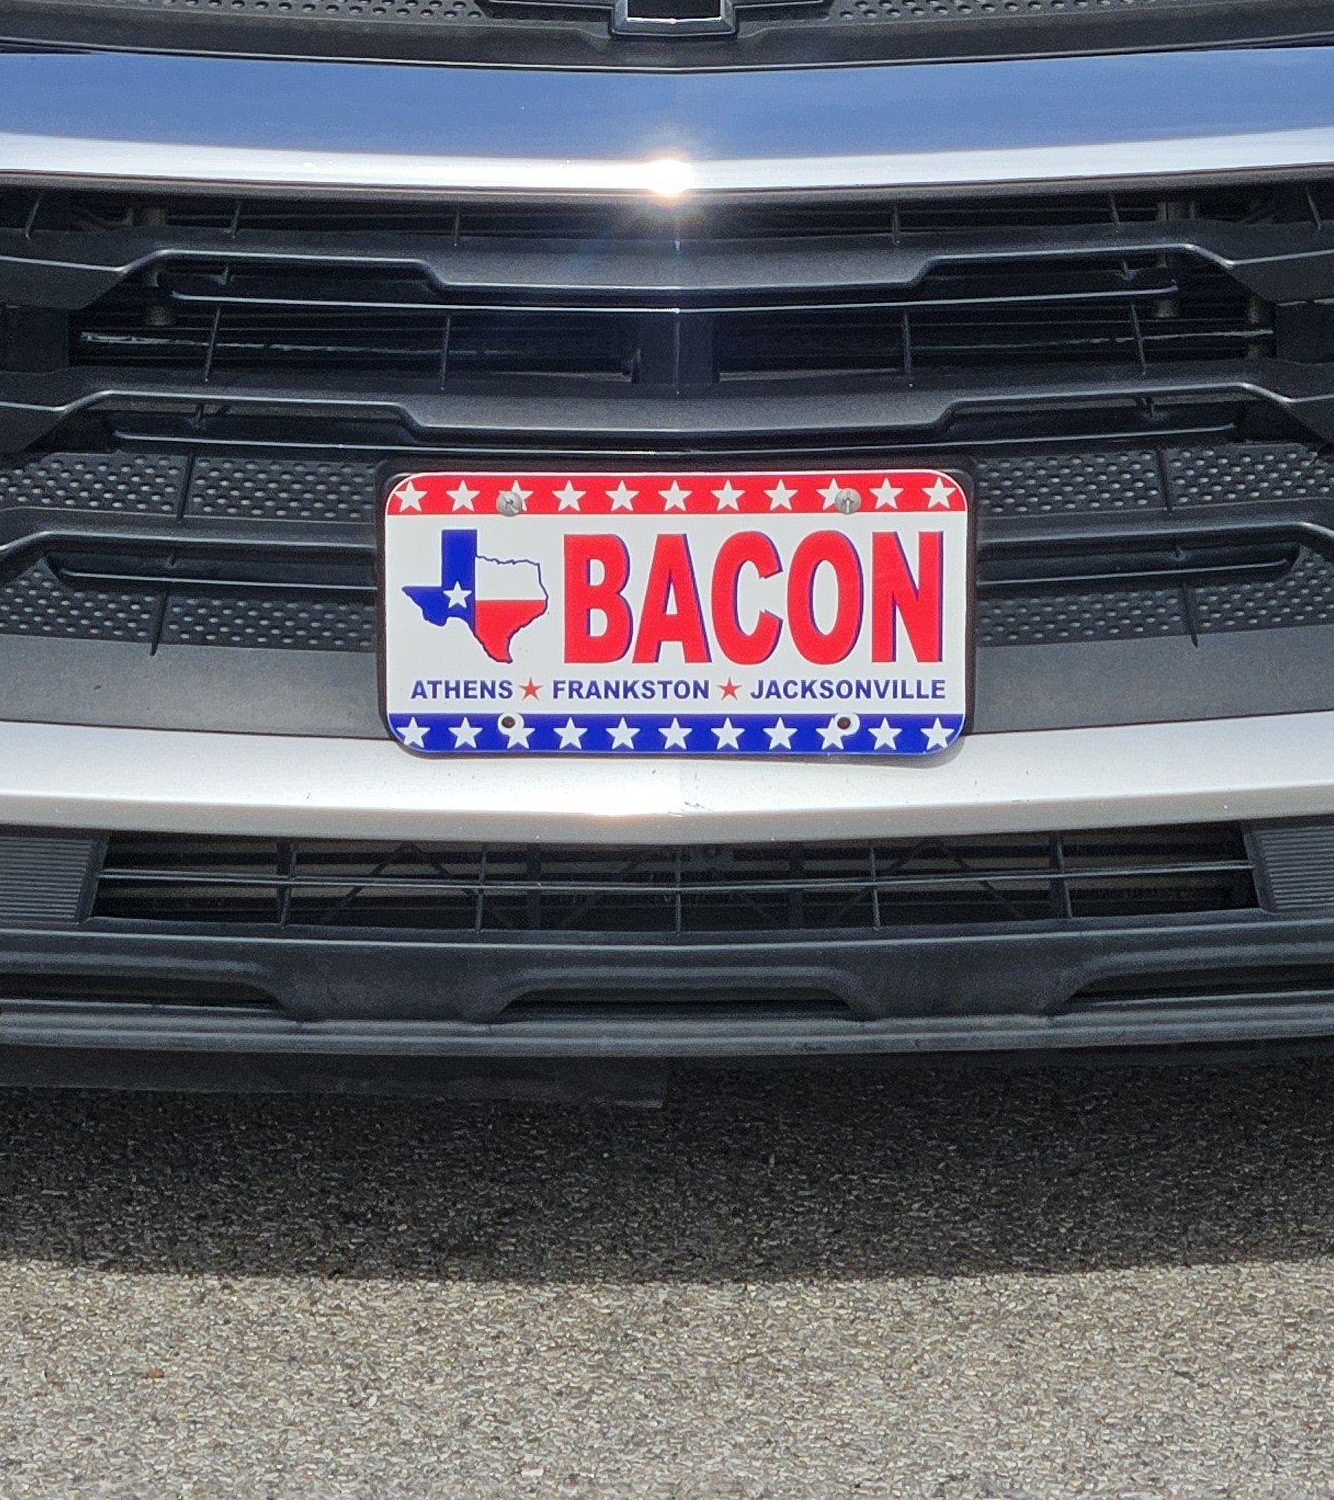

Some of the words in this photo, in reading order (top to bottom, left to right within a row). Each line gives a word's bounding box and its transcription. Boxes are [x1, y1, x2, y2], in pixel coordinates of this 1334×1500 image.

[563, 530, 944, 665] BACON
[410, 679, 514, 700] ATHENS
[552, 679, 710, 700] FRANKSTON
[750, 679, 946, 700] JACKSONVILLE
